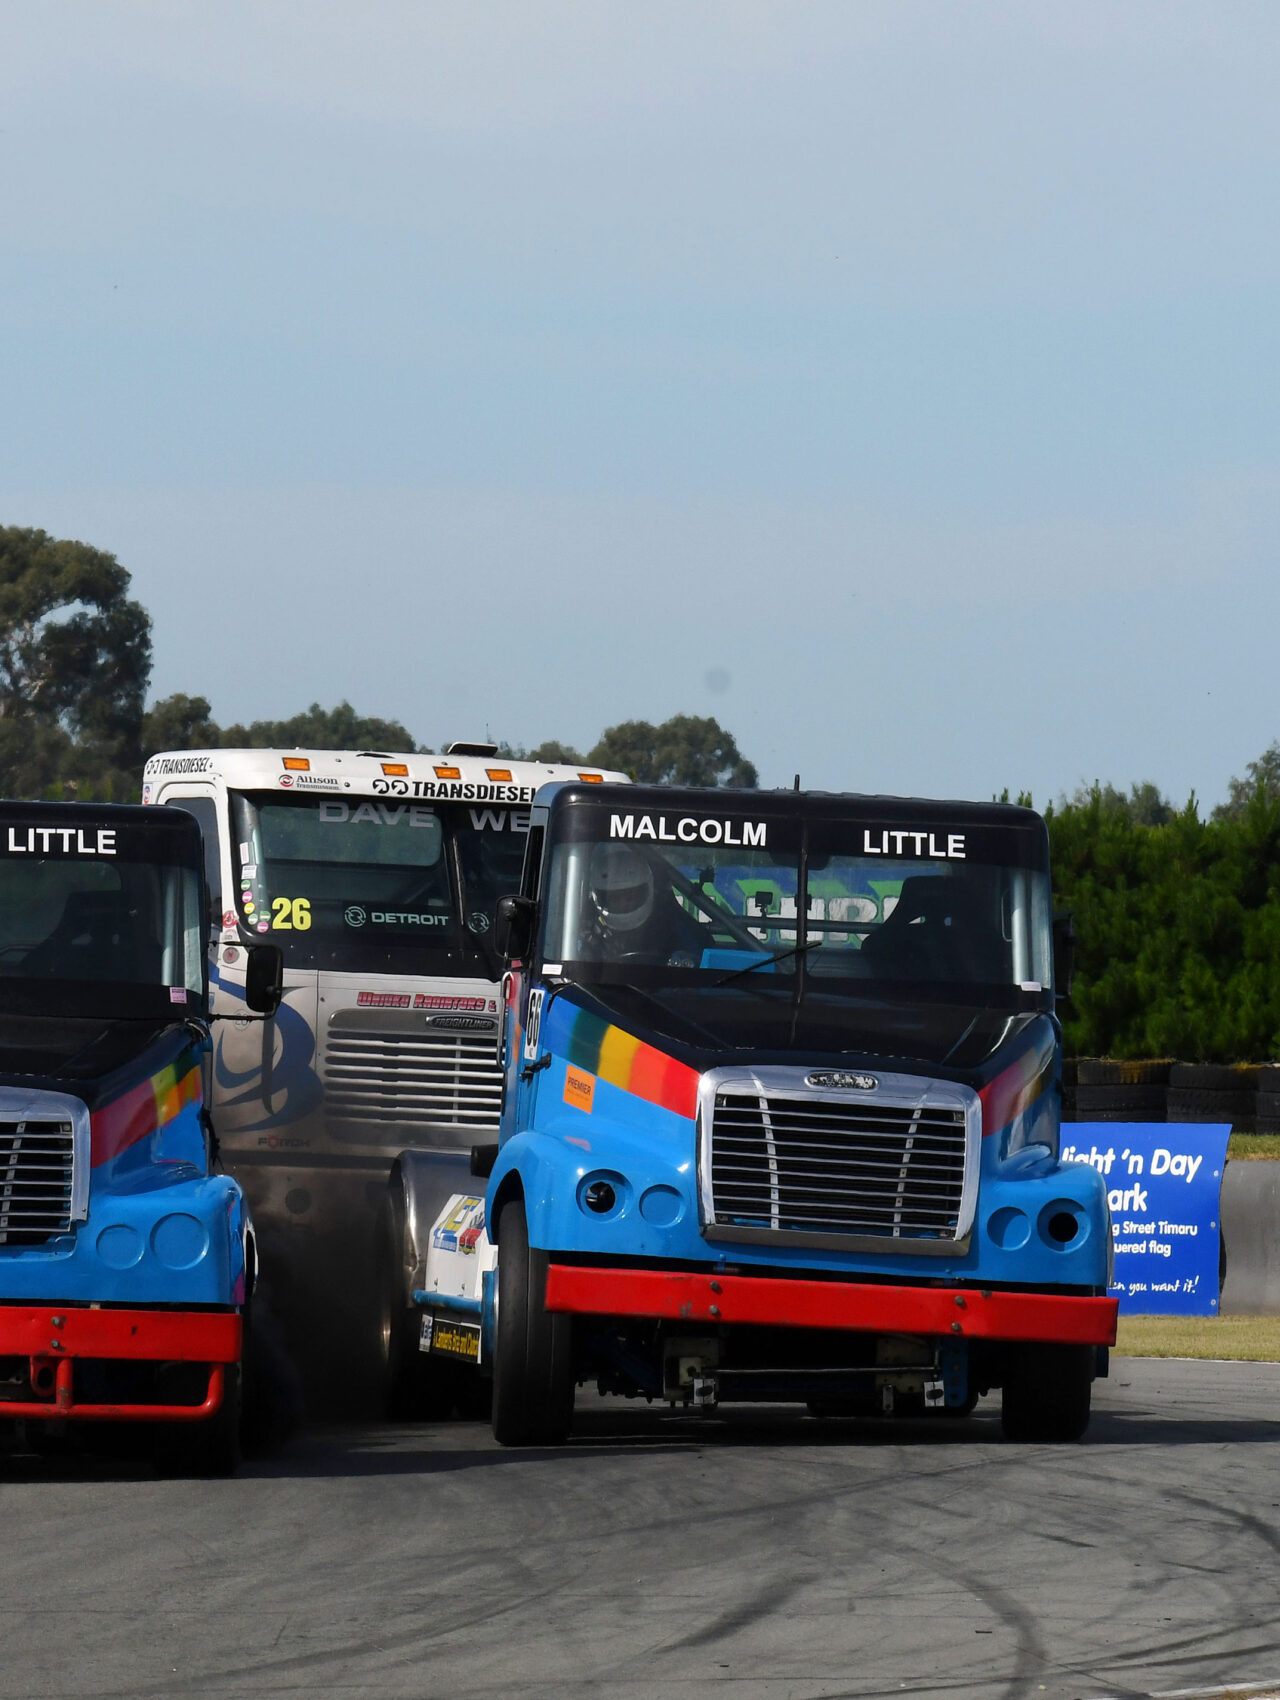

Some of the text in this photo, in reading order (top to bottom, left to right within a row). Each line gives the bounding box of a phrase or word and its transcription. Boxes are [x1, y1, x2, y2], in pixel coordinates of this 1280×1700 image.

[159, 757, 210, 774] TRANSDIESEL
[296, 775, 338, 785] Allison
[319, 801, 434, 828] DAVE
[8, 828, 116, 855] LITTLE
[609, 814, 966, 859] MALCOLM LITTLE
[271, 897, 312, 930] 26
[371, 912, 448, 926] DETROIT
[413, 994, 486, 1011] RADIATORS
[434, 1018, 493, 1029] FREIGHTLINER
[567, 1076, 592, 1096] PREMIER
[1150, 1149, 1203, 1184] Day
[1122, 1221, 1156, 1234] Street
[1158, 1221, 1198, 1236] Timaru
[1148, 1240, 1172, 1257] flag
[1128, 1283, 1147, 1296] you
[1151, 1279, 1181, 1292] want
[1183, 1275, 1200, 1294] it!
